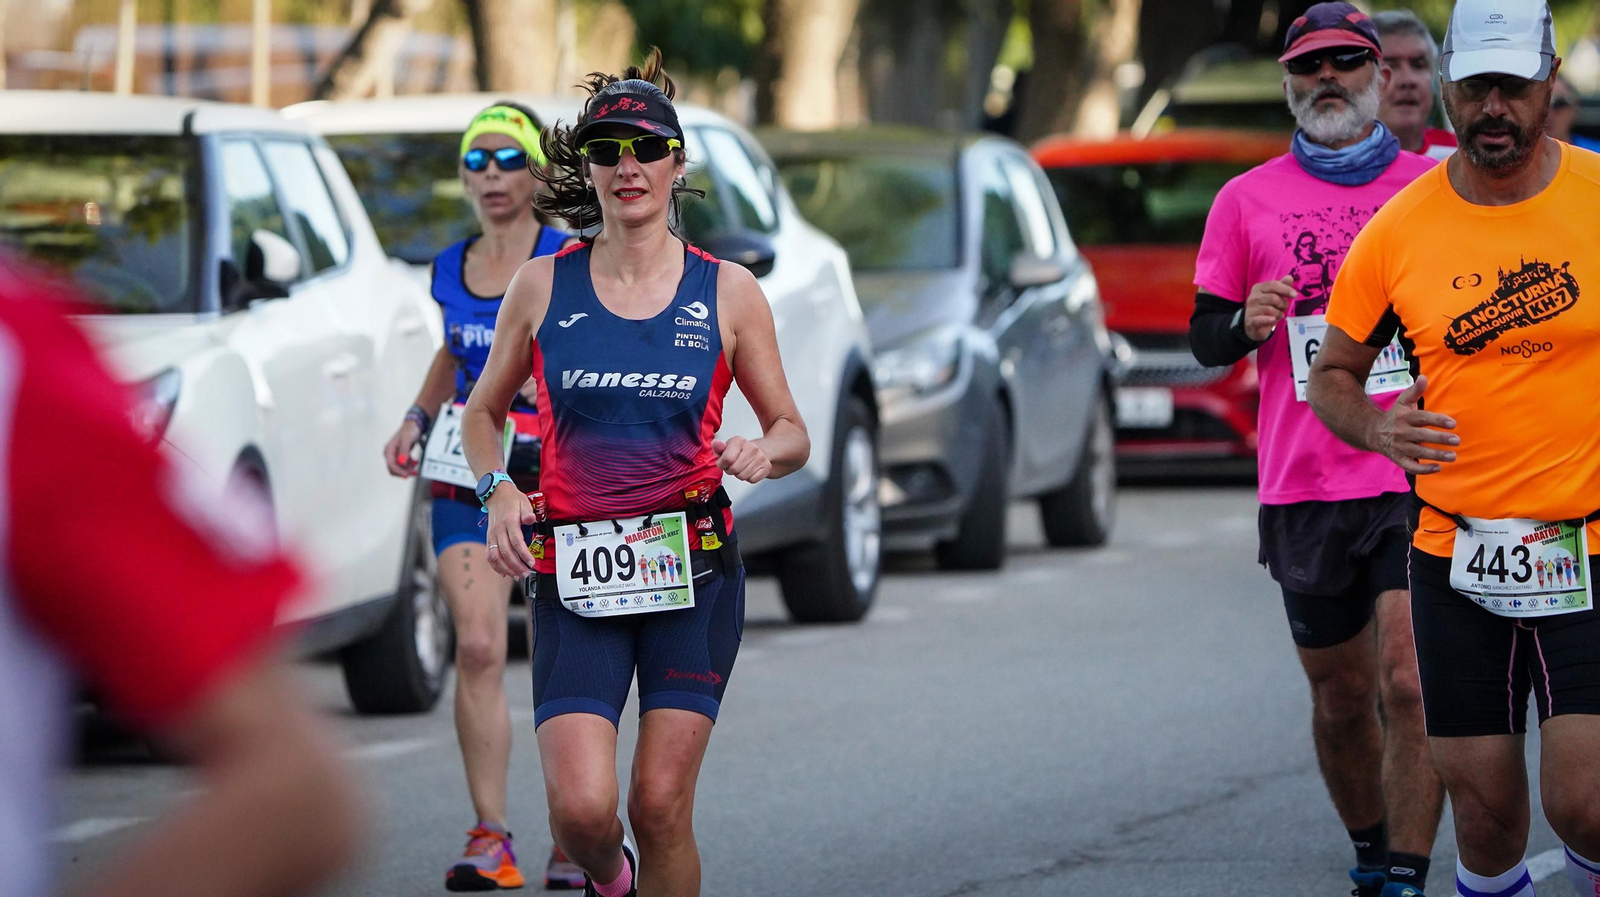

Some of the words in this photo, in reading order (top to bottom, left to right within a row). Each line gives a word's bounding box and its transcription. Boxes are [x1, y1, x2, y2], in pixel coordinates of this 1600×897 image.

[1449, 319, 1474, 339] LA
[1471, 273, 1568, 323] NOCTURNA
[1529, 289, 1569, 317] KH-7
[674, 316, 711, 331] Climatiza
[1455, 307, 1525, 346] GUADALQUIVIR
[674, 339, 686, 347] EL
[562, 369, 698, 391] Vanessa
[638, 389, 692, 400] CALZADOS
[570, 544, 636, 585] 409
[1466, 543, 1533, 583] 443
[579, 585, 600, 593] YOLANDA
